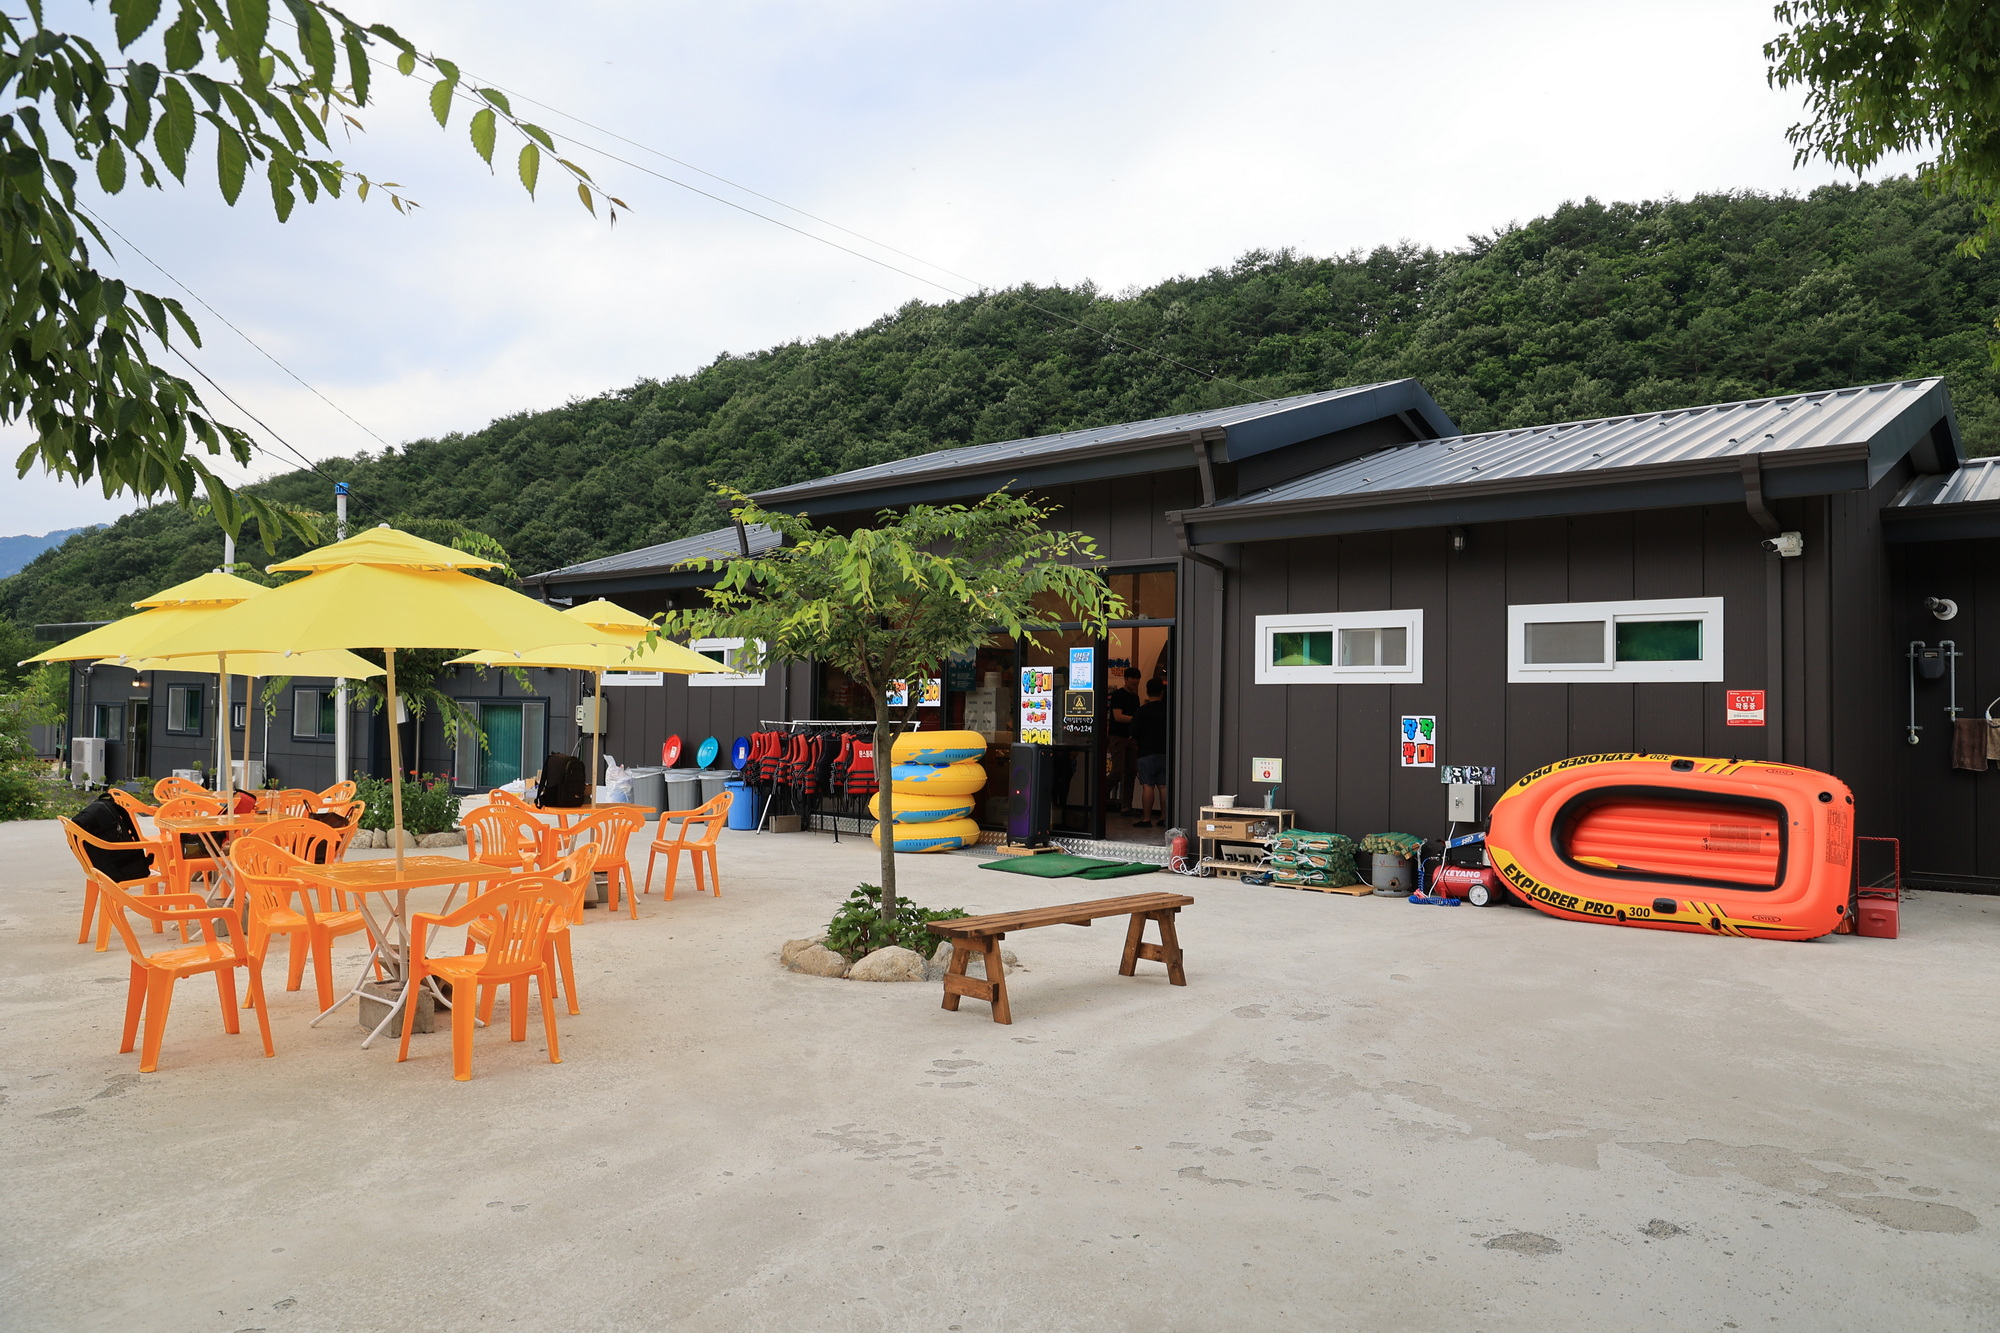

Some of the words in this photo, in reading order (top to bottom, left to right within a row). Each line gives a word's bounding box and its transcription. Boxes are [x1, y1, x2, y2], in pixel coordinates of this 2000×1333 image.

[1022, 698, 1051, 710] 아이스크림
[1735, 702, 1756, 710] 작동중
[1403, 718, 1434, 740] 장작
[1403, 741, 1434, 764] 판매
[1649, 753, 1672, 761] 300
[1558, 753, 1635, 769] EXPLORER
[1518, 765, 1552, 787] PRO
[1442, 869, 1481, 878] KEYANG
[1503, 863, 1579, 909] EXPLORER
[1583, 900, 1614, 915] PRO
[1628, 906, 1650, 917] 300
